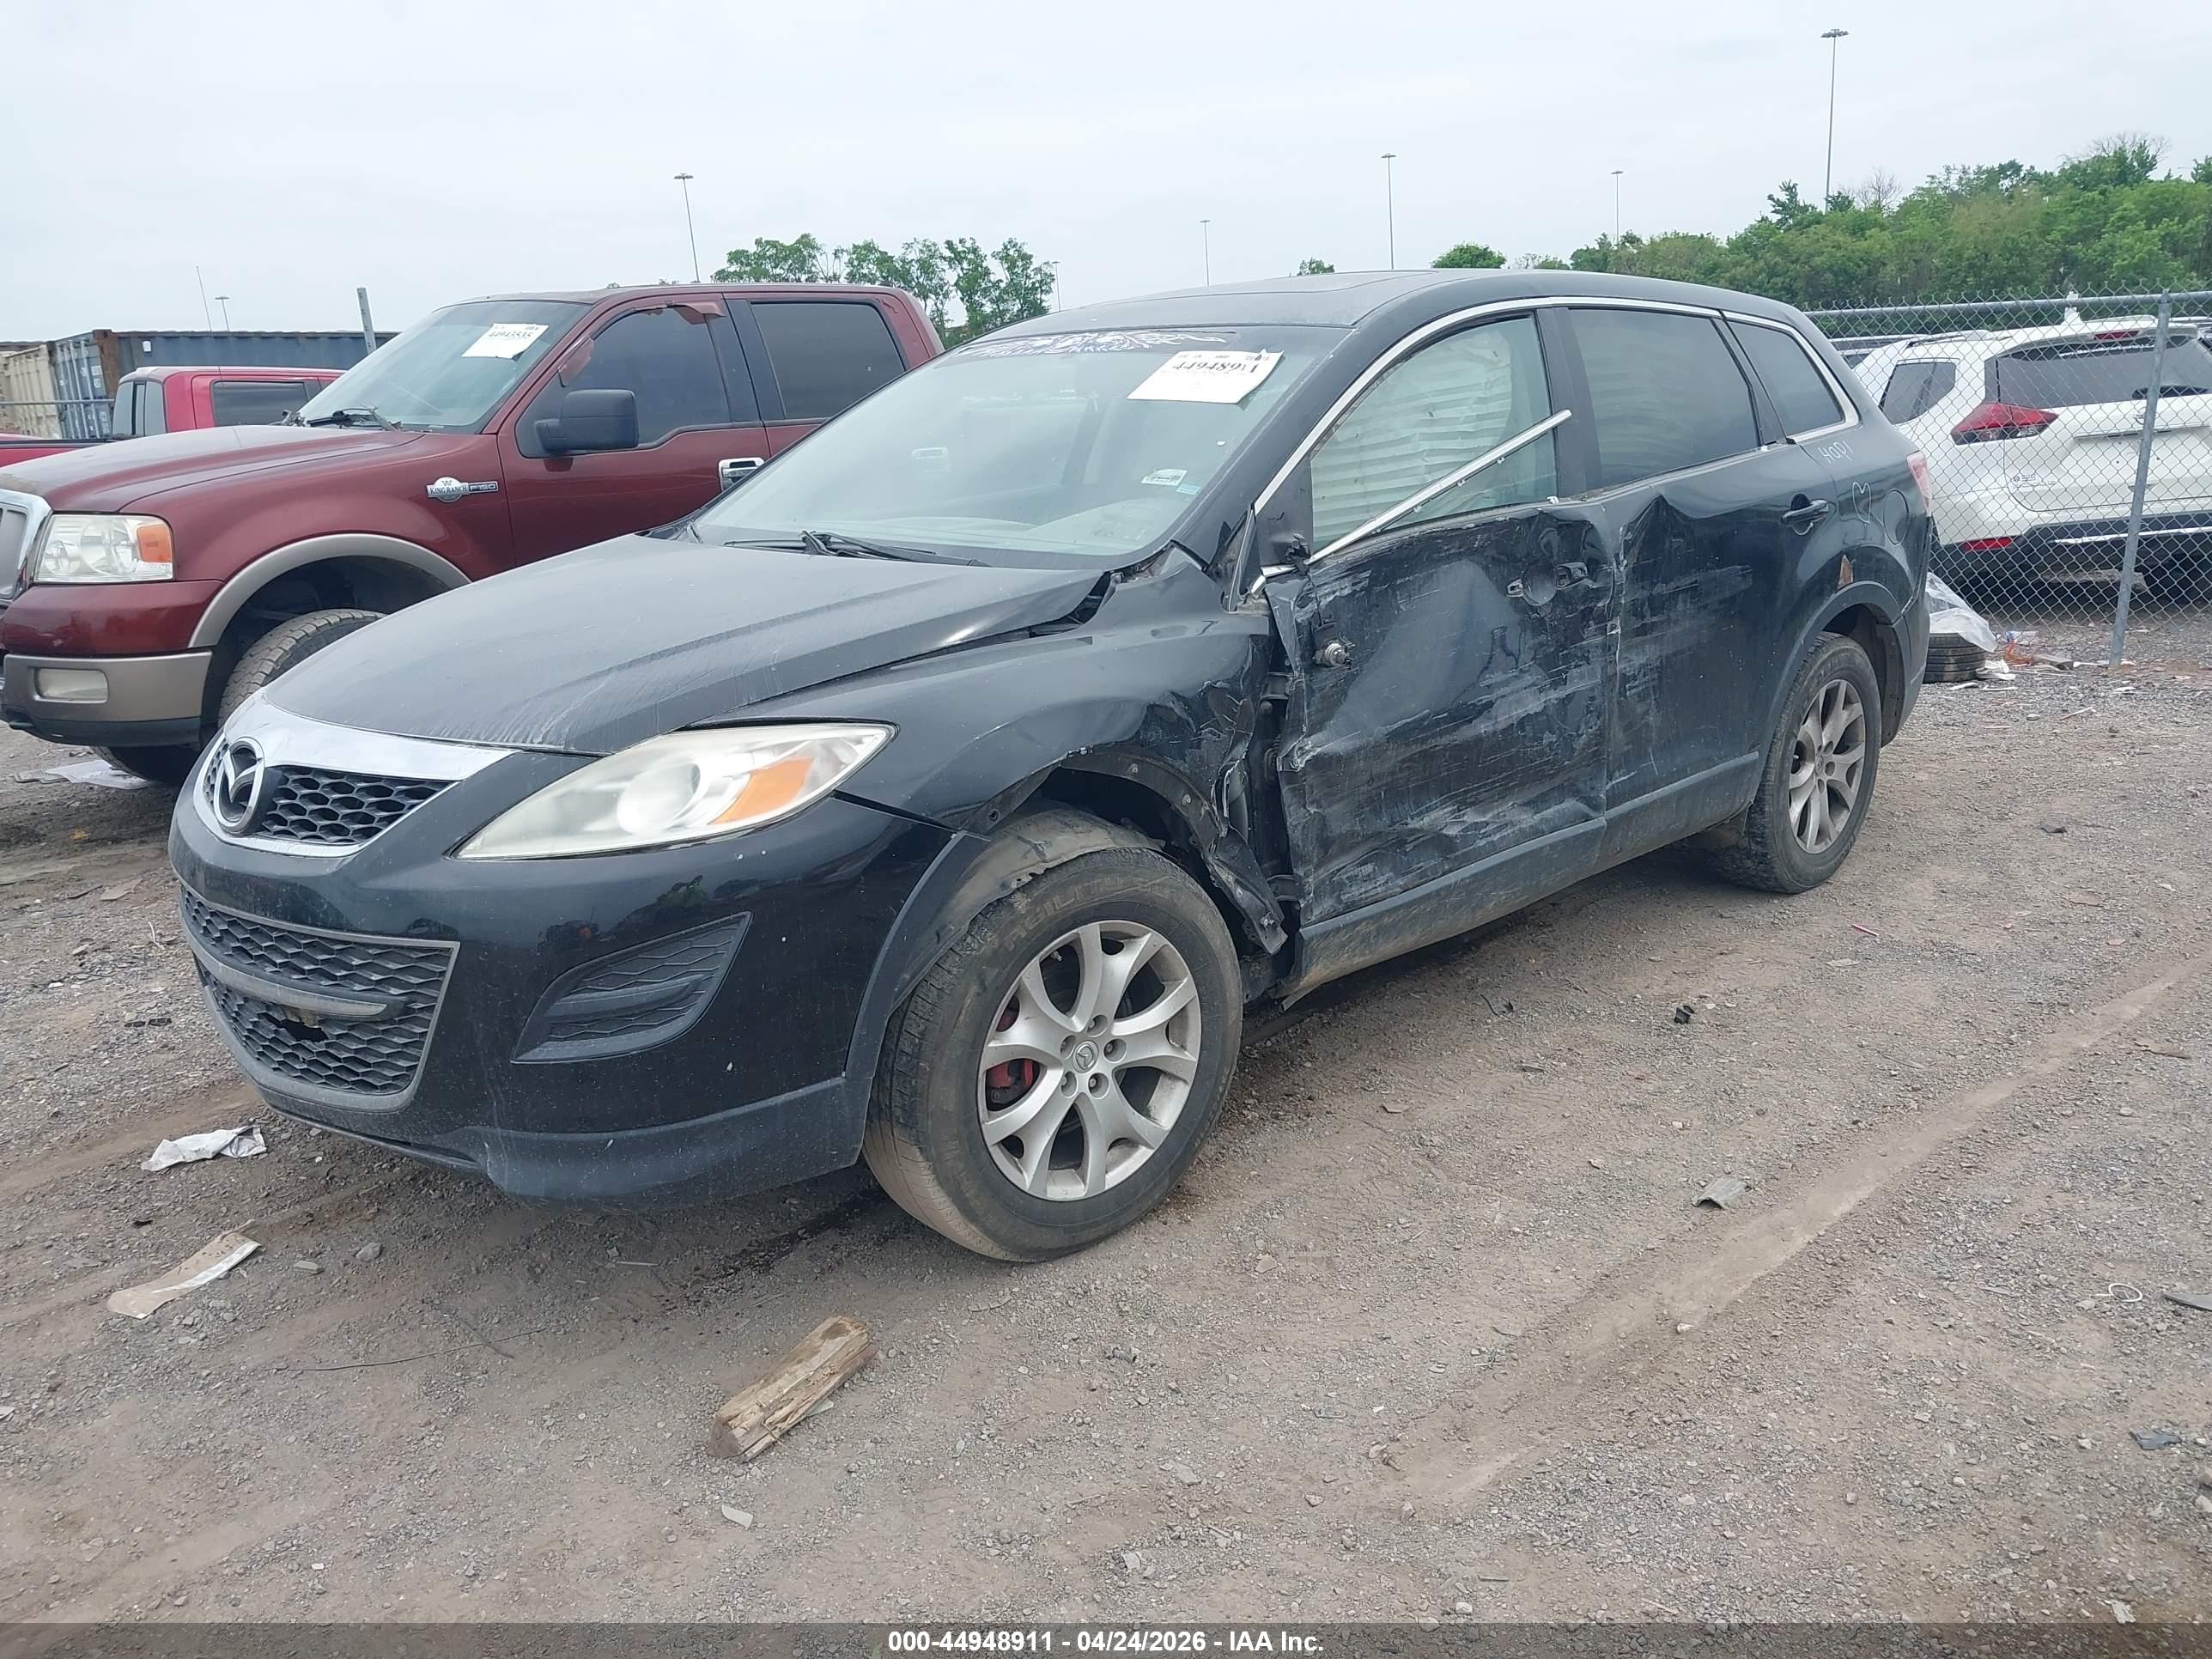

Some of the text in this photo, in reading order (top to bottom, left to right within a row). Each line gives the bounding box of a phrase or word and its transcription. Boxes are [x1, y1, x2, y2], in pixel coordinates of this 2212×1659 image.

[1172, 360, 1259, 374] 44948911
[430, 487, 446, 495] KING
[447, 484, 468, 494] RANCH
